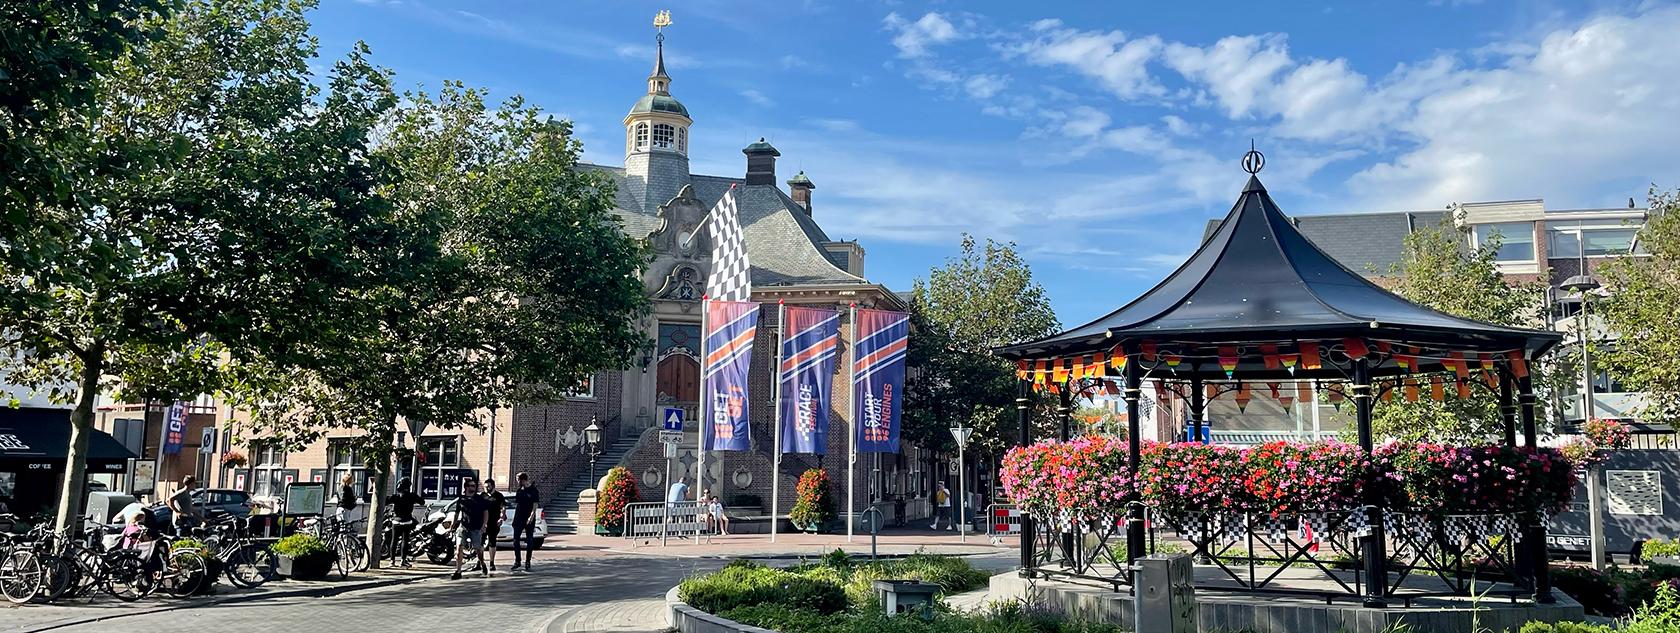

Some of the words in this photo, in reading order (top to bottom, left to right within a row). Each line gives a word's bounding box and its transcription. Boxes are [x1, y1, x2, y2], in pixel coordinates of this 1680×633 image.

[170, 401, 184, 432] GET
[714, 389, 729, 424] GET
[799, 383, 812, 419] RACE
[864, 391, 874, 428] START
[873, 398, 882, 428] YOUR
[881, 383, 893, 429] ENGINES
